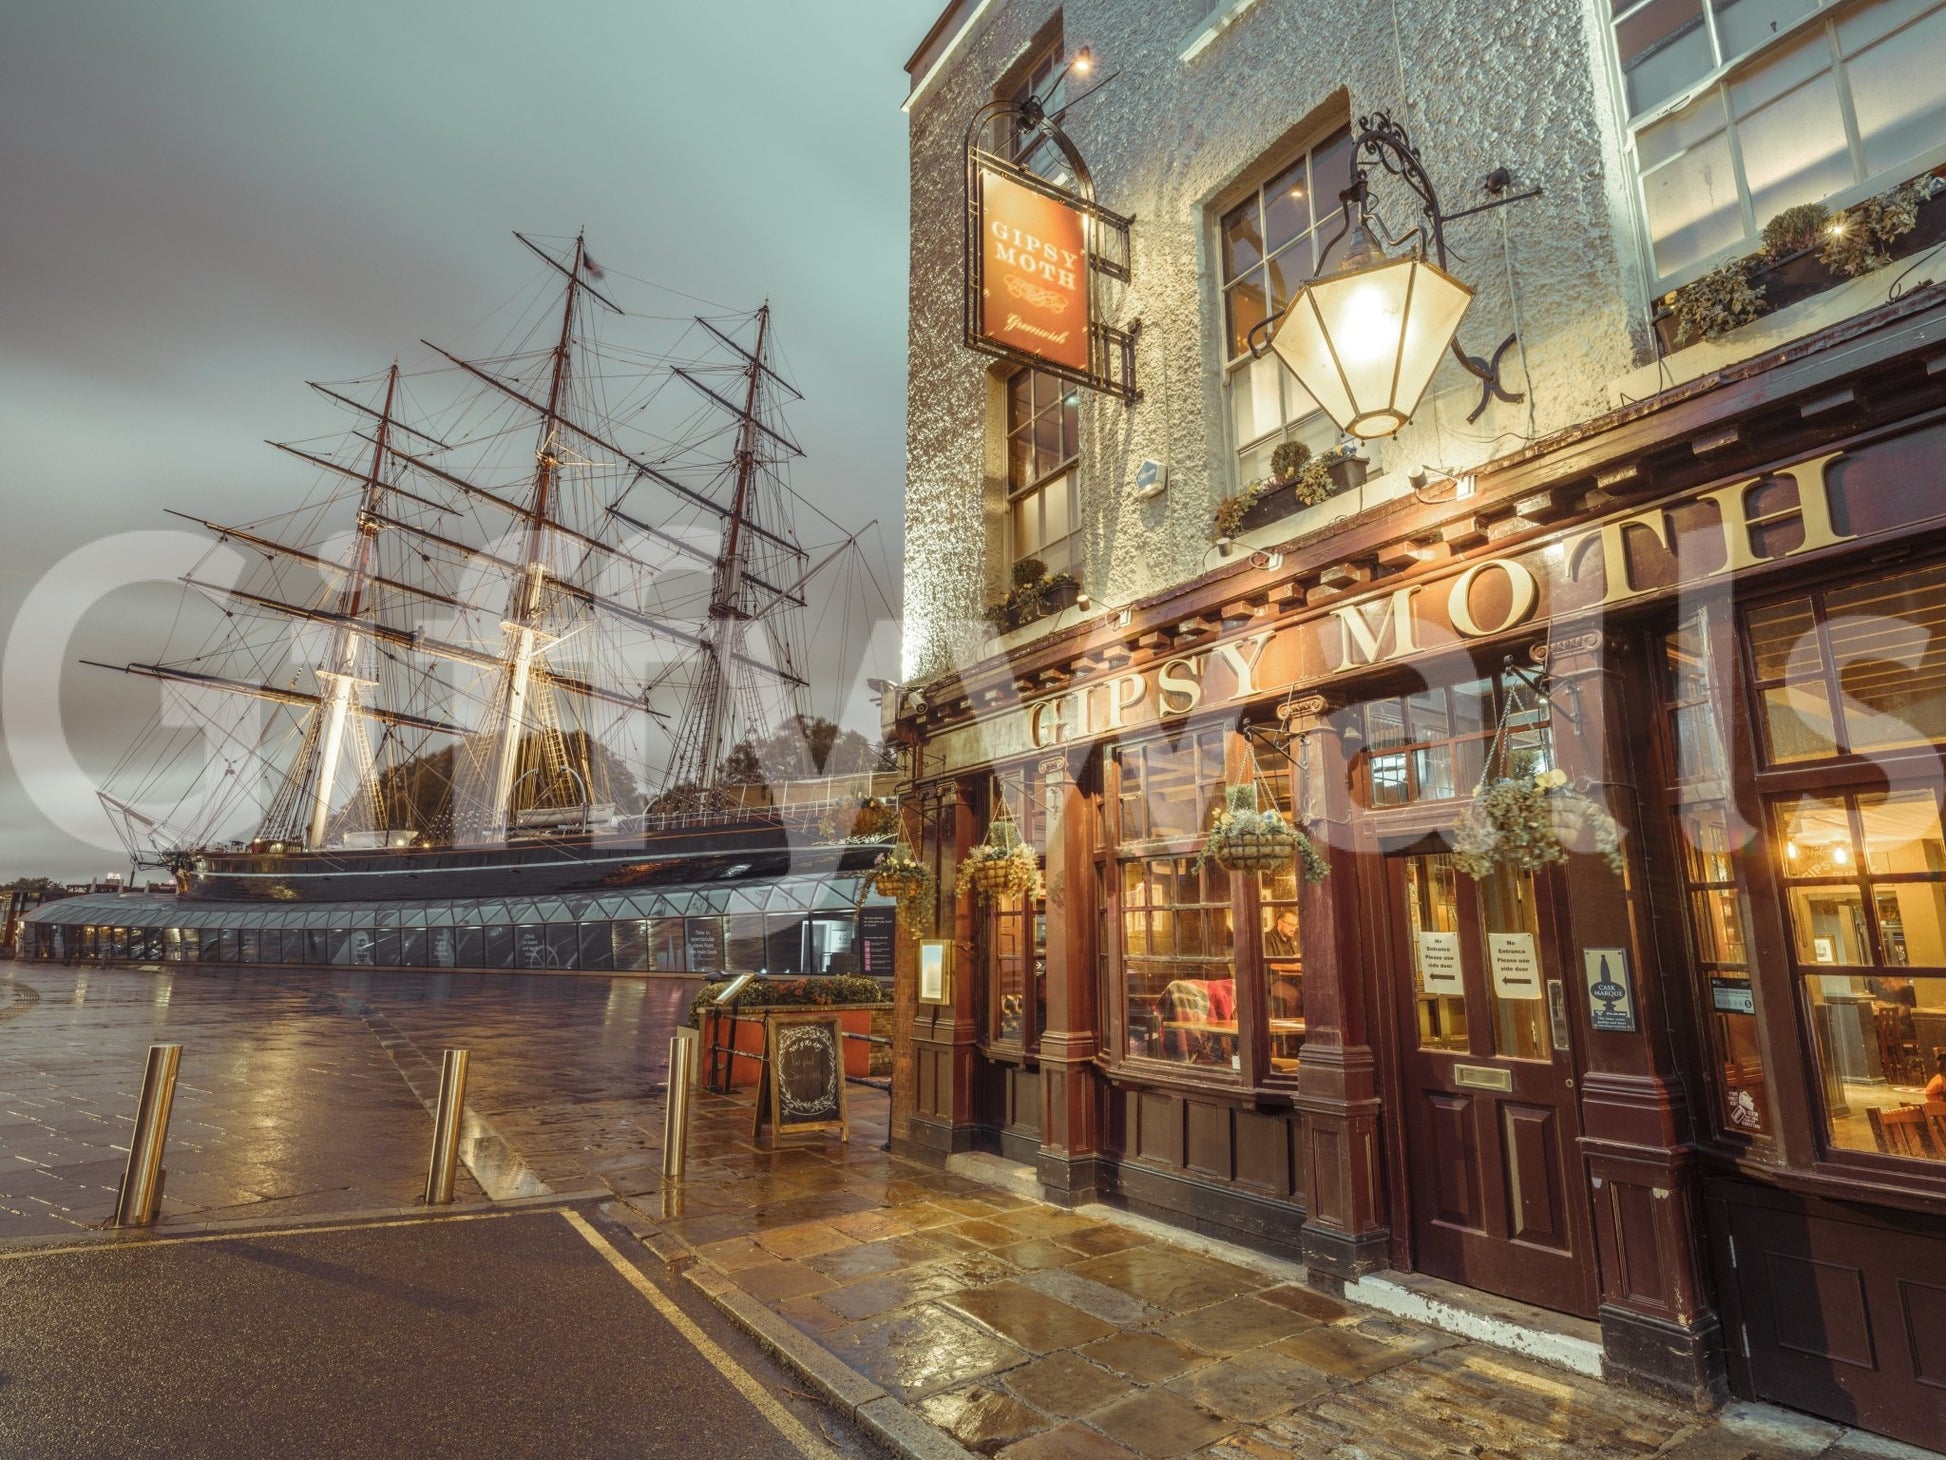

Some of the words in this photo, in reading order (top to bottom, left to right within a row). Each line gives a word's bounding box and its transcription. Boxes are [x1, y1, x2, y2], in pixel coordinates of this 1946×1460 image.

[991, 220, 1078, 269] GIPSY
[994, 241, 1077, 290] MOTH
[1029, 630, 1275, 750] GIPSY
[1329, 451, 1859, 674] MOTH
